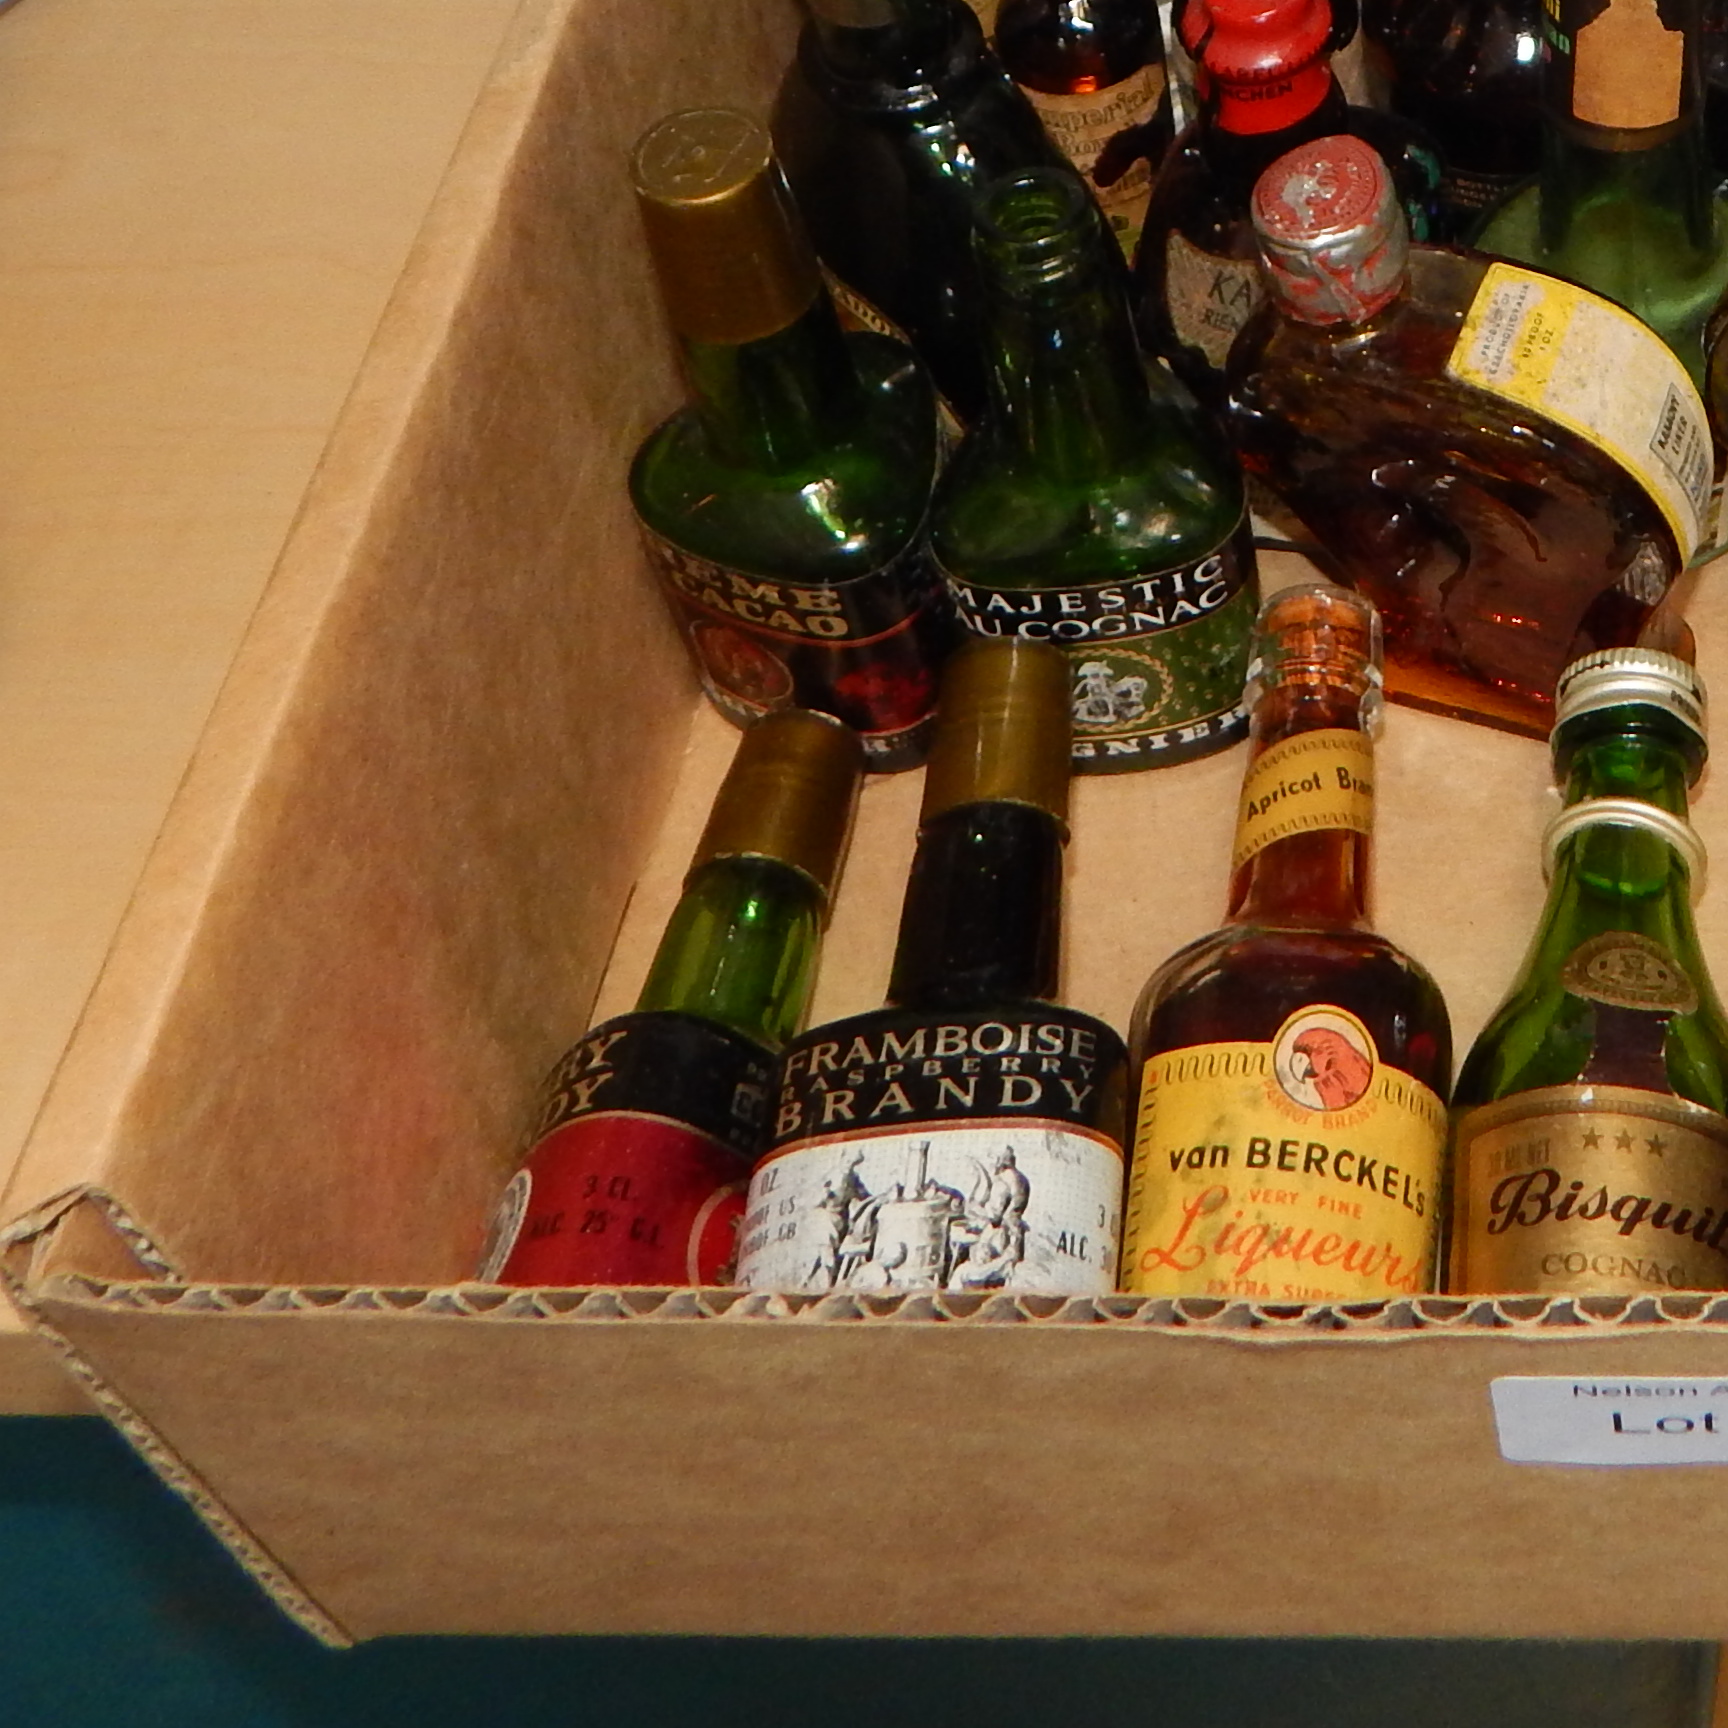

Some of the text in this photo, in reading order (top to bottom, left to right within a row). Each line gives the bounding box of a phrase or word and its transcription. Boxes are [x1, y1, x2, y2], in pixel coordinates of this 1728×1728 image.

[946, 554, 1223, 615] MAJESTIC
[1017, 580, 1229, 641] COGNAC
[1247, 771, 1322, 822] Apricot
[783, 1020, 1097, 1086] FRAMBOISE
[779, 1055, 1095, 1106] RASPBERRY
[774, 1074, 1095, 1139] BRANDY
[1169, 1143, 1230, 1173] van
[1248, 1187, 1365, 1221] VERY FINE
[1139, 1184, 1425, 1294] Liqueurs
[1540, 1251, 1688, 1288] COGNAC
[1572, 1383, 1698, 1399] Nelson
[1611, 1409, 1721, 1435] Lot
